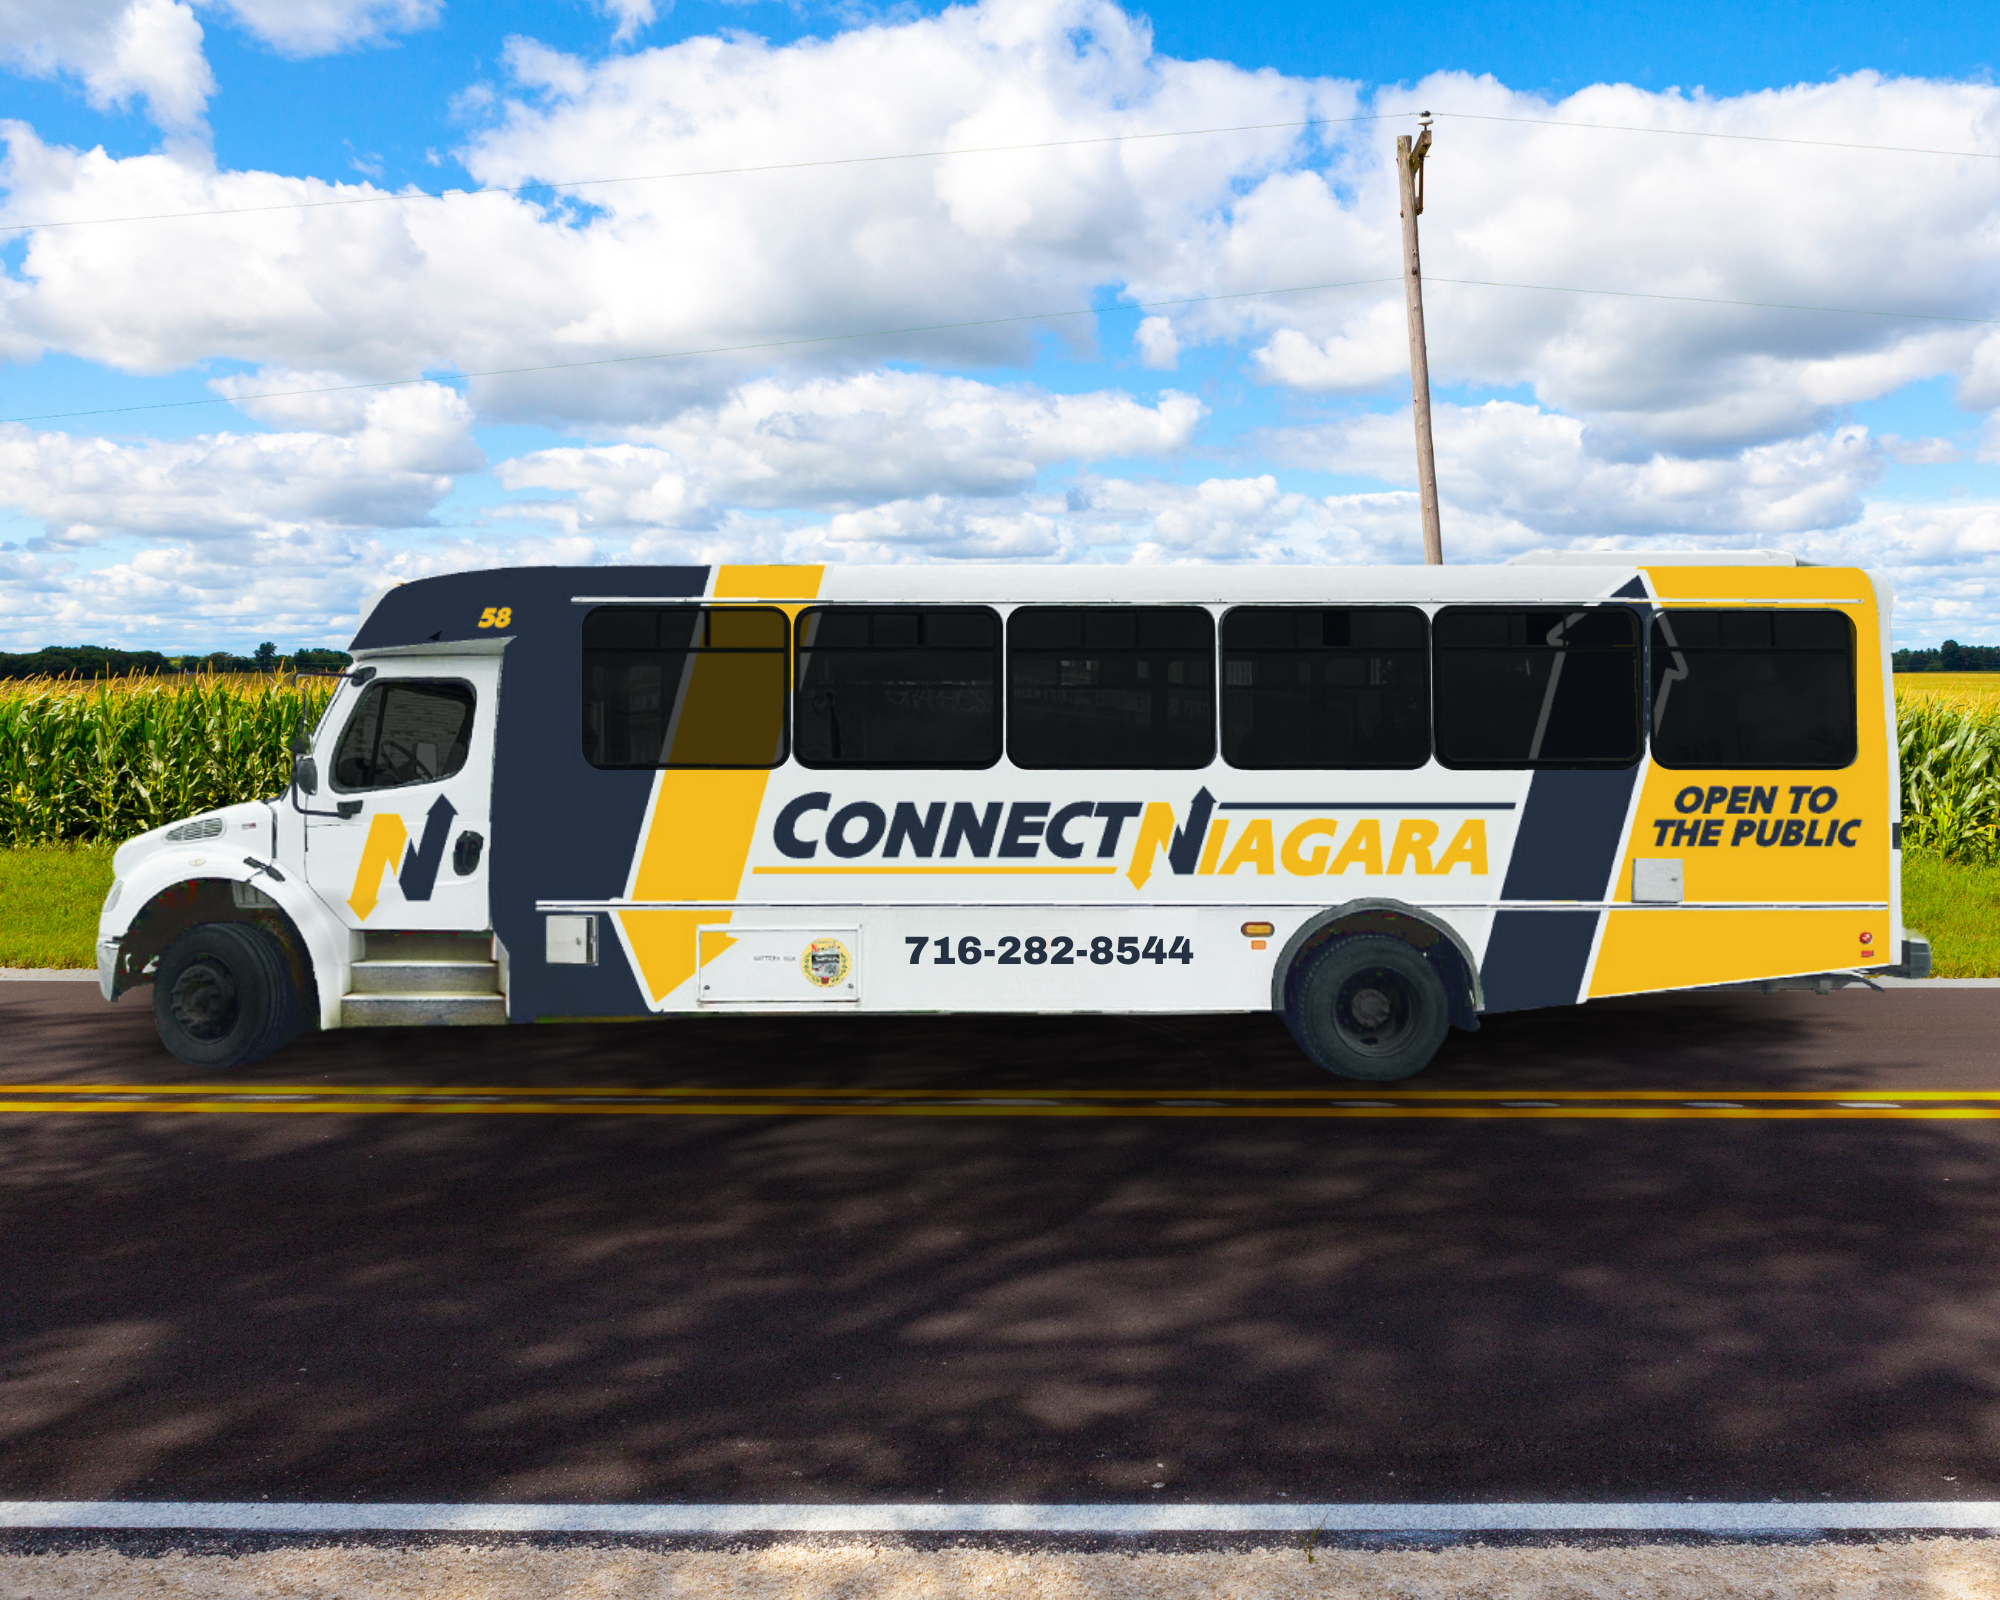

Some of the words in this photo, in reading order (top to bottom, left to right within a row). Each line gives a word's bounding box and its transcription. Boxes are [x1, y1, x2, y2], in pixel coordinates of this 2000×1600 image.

[477, 607, 512, 629] 58
[1674, 785, 1779, 814] OPEN
[1788, 785, 1838, 814] TO
[1653, 819, 1725, 847] THE
[1730, 819, 1862, 848] PUBLIC
[905, 935, 1194, 965] 716-282-8544
